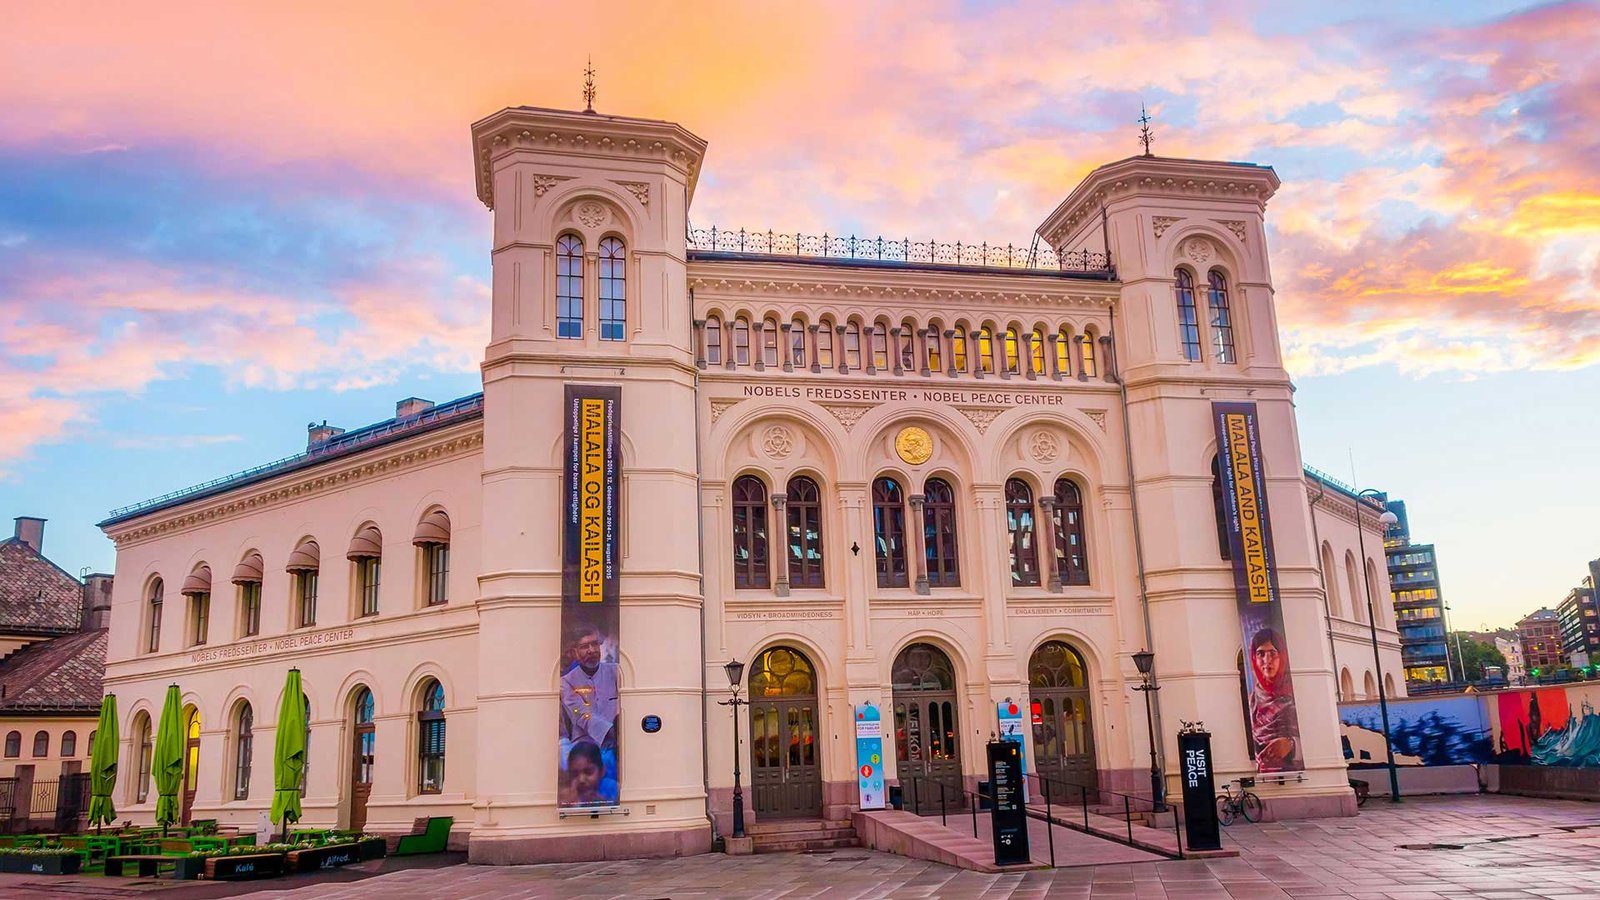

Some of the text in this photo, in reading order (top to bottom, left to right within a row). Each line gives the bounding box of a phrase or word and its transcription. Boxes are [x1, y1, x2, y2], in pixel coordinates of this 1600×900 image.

[744, 386, 1063, 405] NOBELS FREDSSENTER NOBEL PEACE CENTER
[1230, 418, 1249, 480] MALALA
[584, 404, 600, 596] MALALA OG KAILASH
[1239, 486, 1254, 520] AND
[1244, 527, 1266, 597] KAILASH
[192, 630, 354, 662] NOBELS FREDSSENTER NOBEL PEACE CENTER
[1186, 750, 1198, 788] PEACE
[1196, 749, 1206, 777] VISIT
